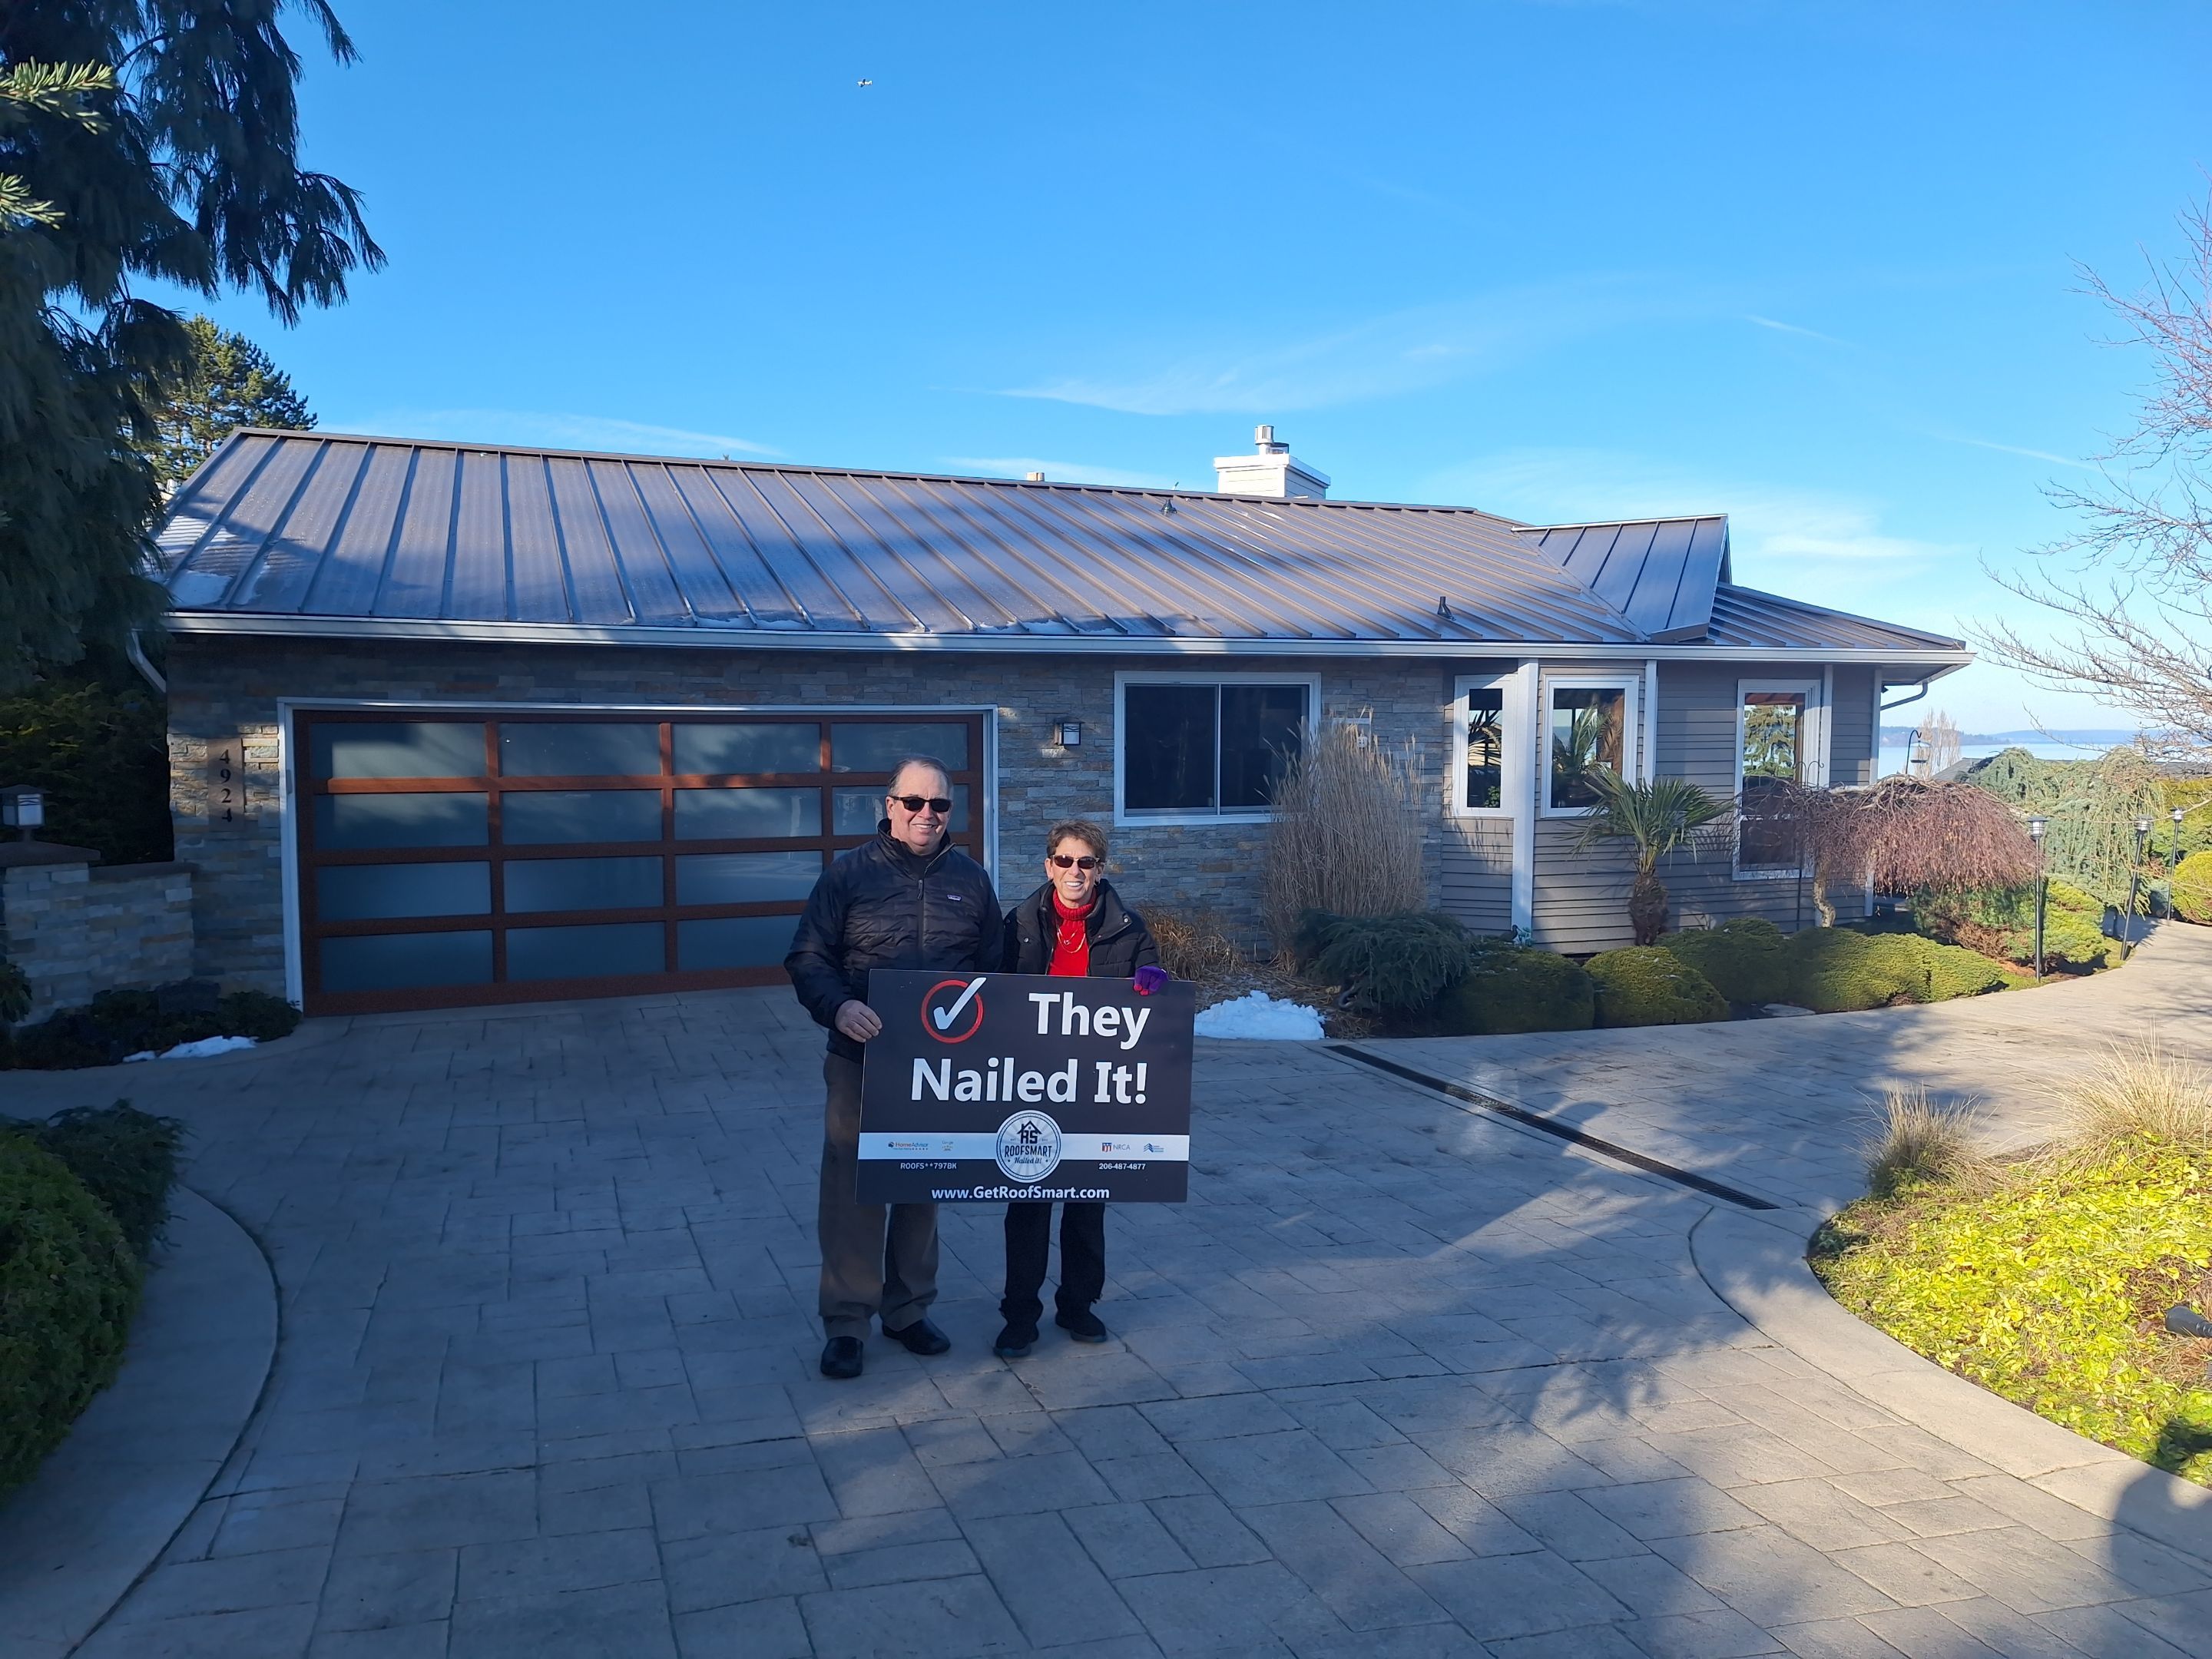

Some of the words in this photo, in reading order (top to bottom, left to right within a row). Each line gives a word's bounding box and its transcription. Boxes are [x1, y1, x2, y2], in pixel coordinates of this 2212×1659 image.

[219, 749, 233, 823] 4924
[1028, 992, 1151, 1051] They
[911, 1057, 1078, 1103] Nailed
[1094, 1061, 1147, 1104] It!
[1005, 1145, 1052, 1157] ROOFSMART
[1021, 1130, 1038, 1144] RS
[931, 1185, 1111, 1200] www.GetRoofSmart.com
